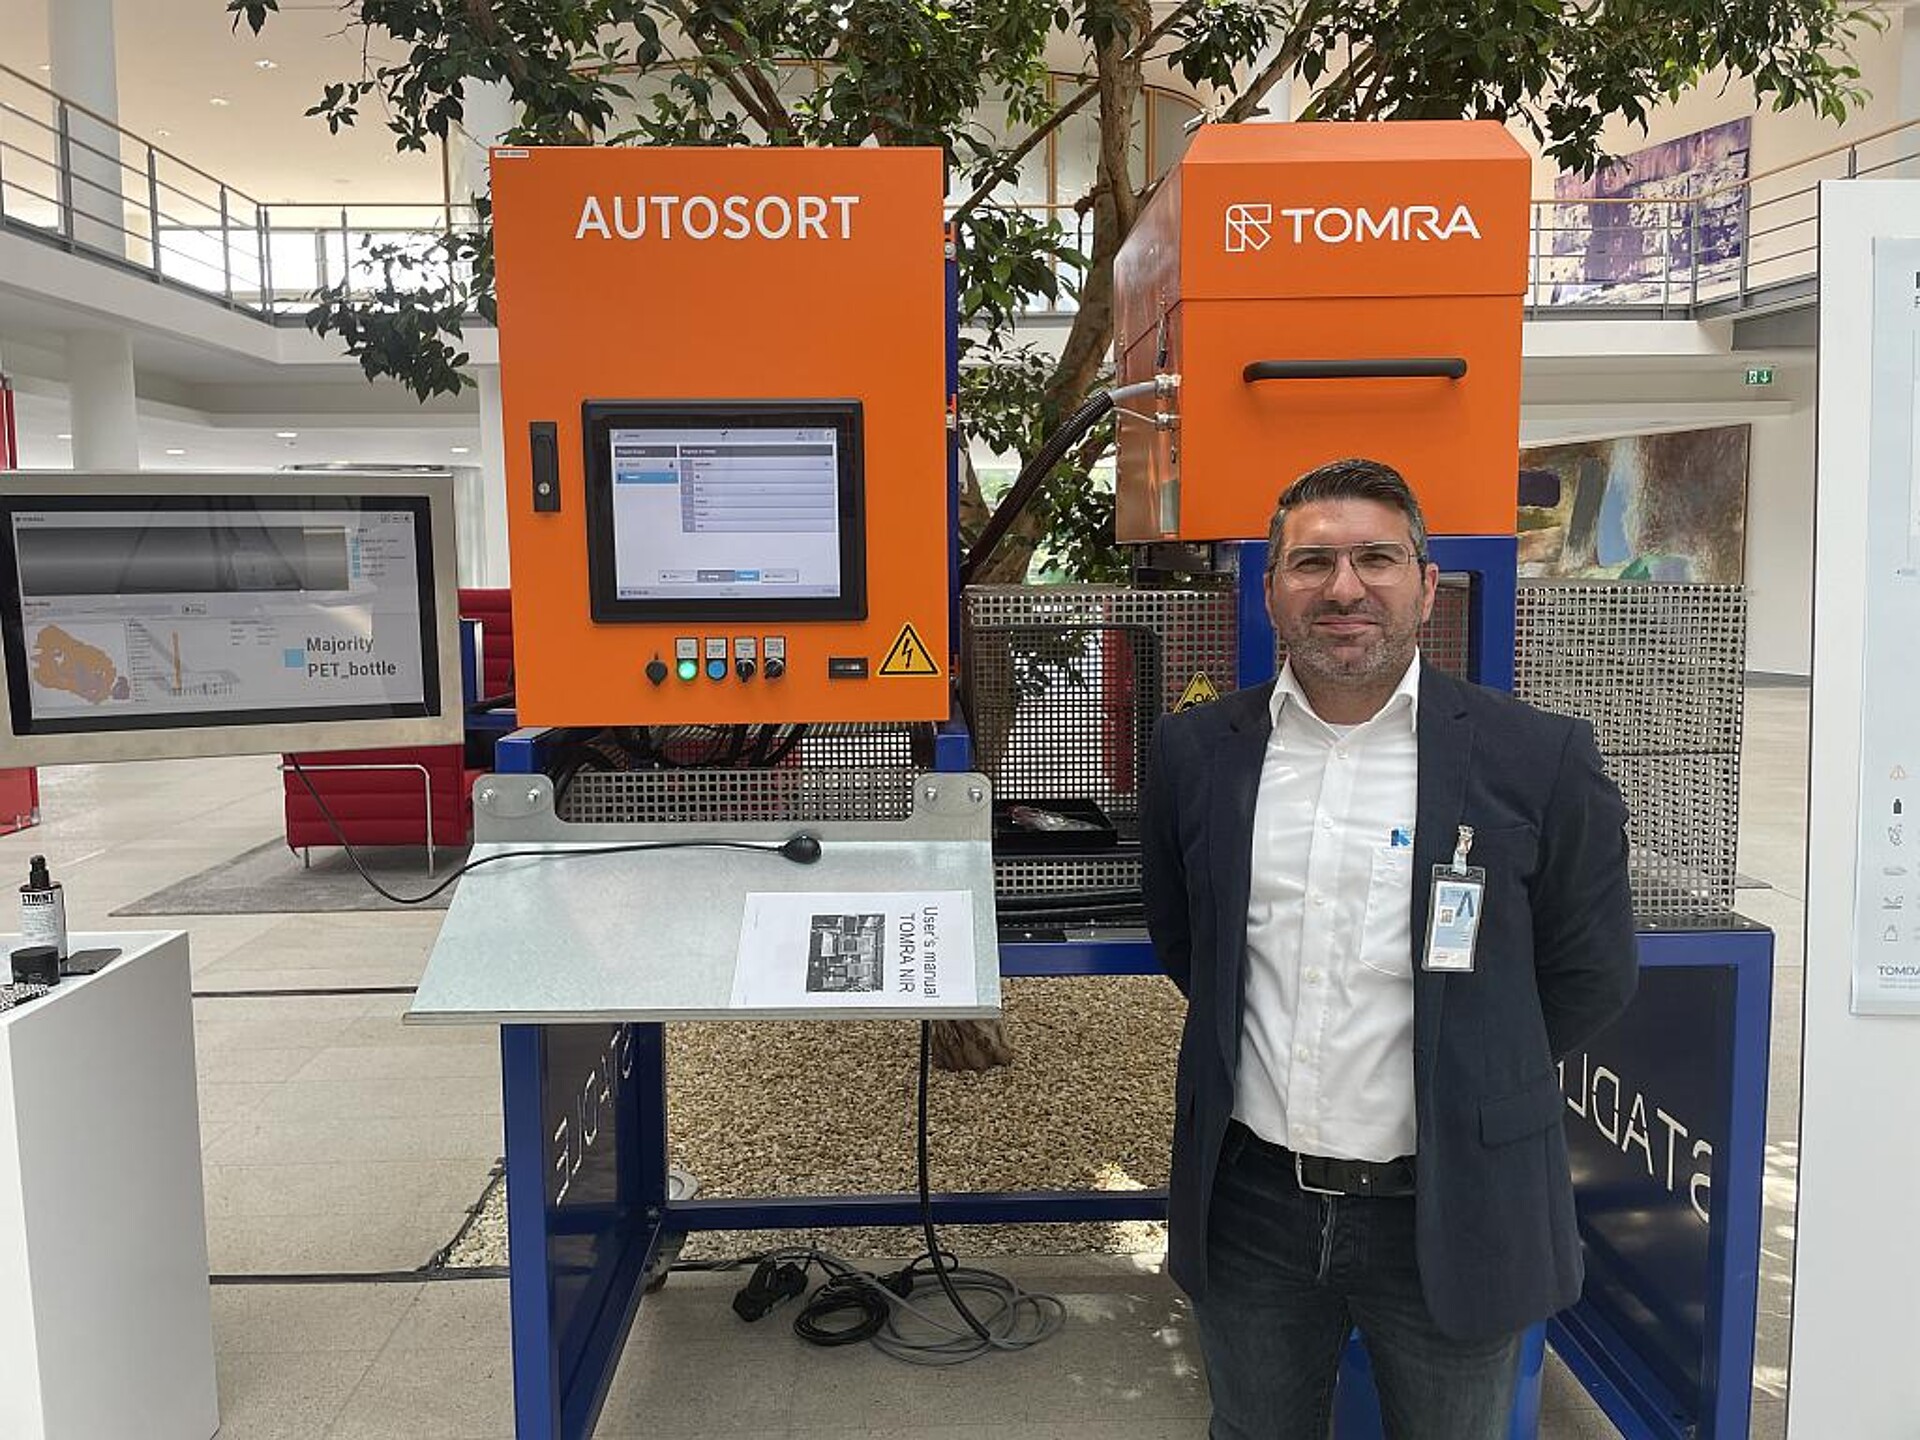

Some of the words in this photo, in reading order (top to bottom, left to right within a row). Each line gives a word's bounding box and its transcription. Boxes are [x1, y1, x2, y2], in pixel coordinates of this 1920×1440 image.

[575, 195, 861, 240] AUTOSORT
[1280, 205, 1482, 244] TOMRA
[306, 635, 375, 653] Majority
[307, 660, 397, 680] PET_bottle
[899, 912, 916, 965] TOMRA
[923, 906, 939, 948] User's
[899, 968, 916, 993] NIR
[923, 951, 940, 998] manual
